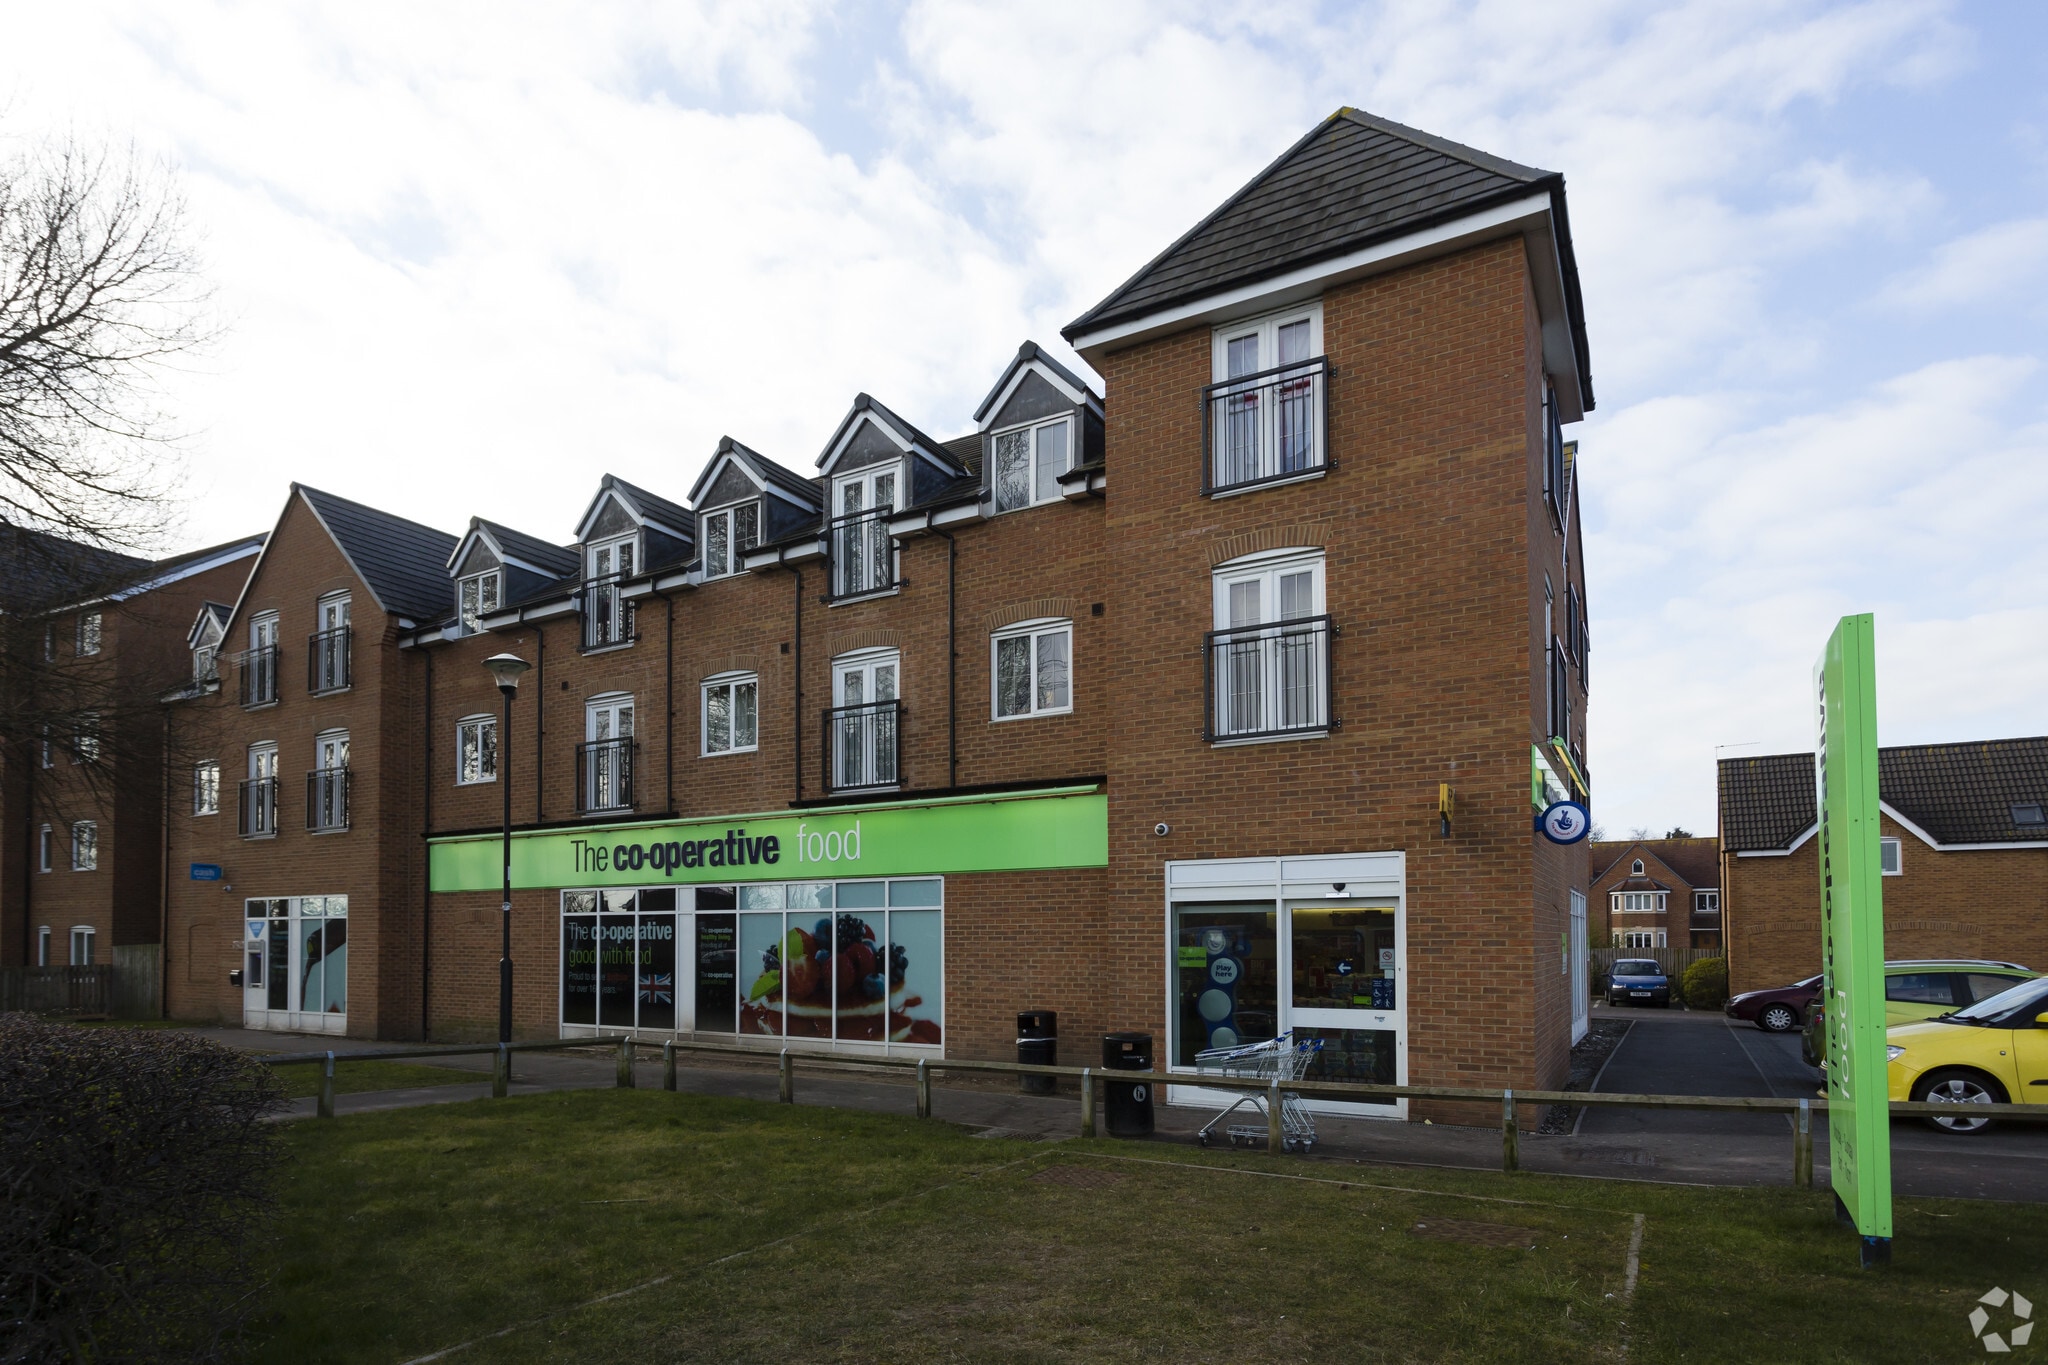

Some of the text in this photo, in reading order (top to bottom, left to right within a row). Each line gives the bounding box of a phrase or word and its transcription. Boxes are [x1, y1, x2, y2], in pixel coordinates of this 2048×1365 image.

[570, 820, 861, 876] The co-operative food
[1818, 670, 1839, 1095] The co-operative
[568, 921, 589, 940] The
[568, 946, 597, 968] good
[600, 947, 623, 965] with
[1216, 964, 1231, 972] Play
[1837, 990, 1850, 1098] food
